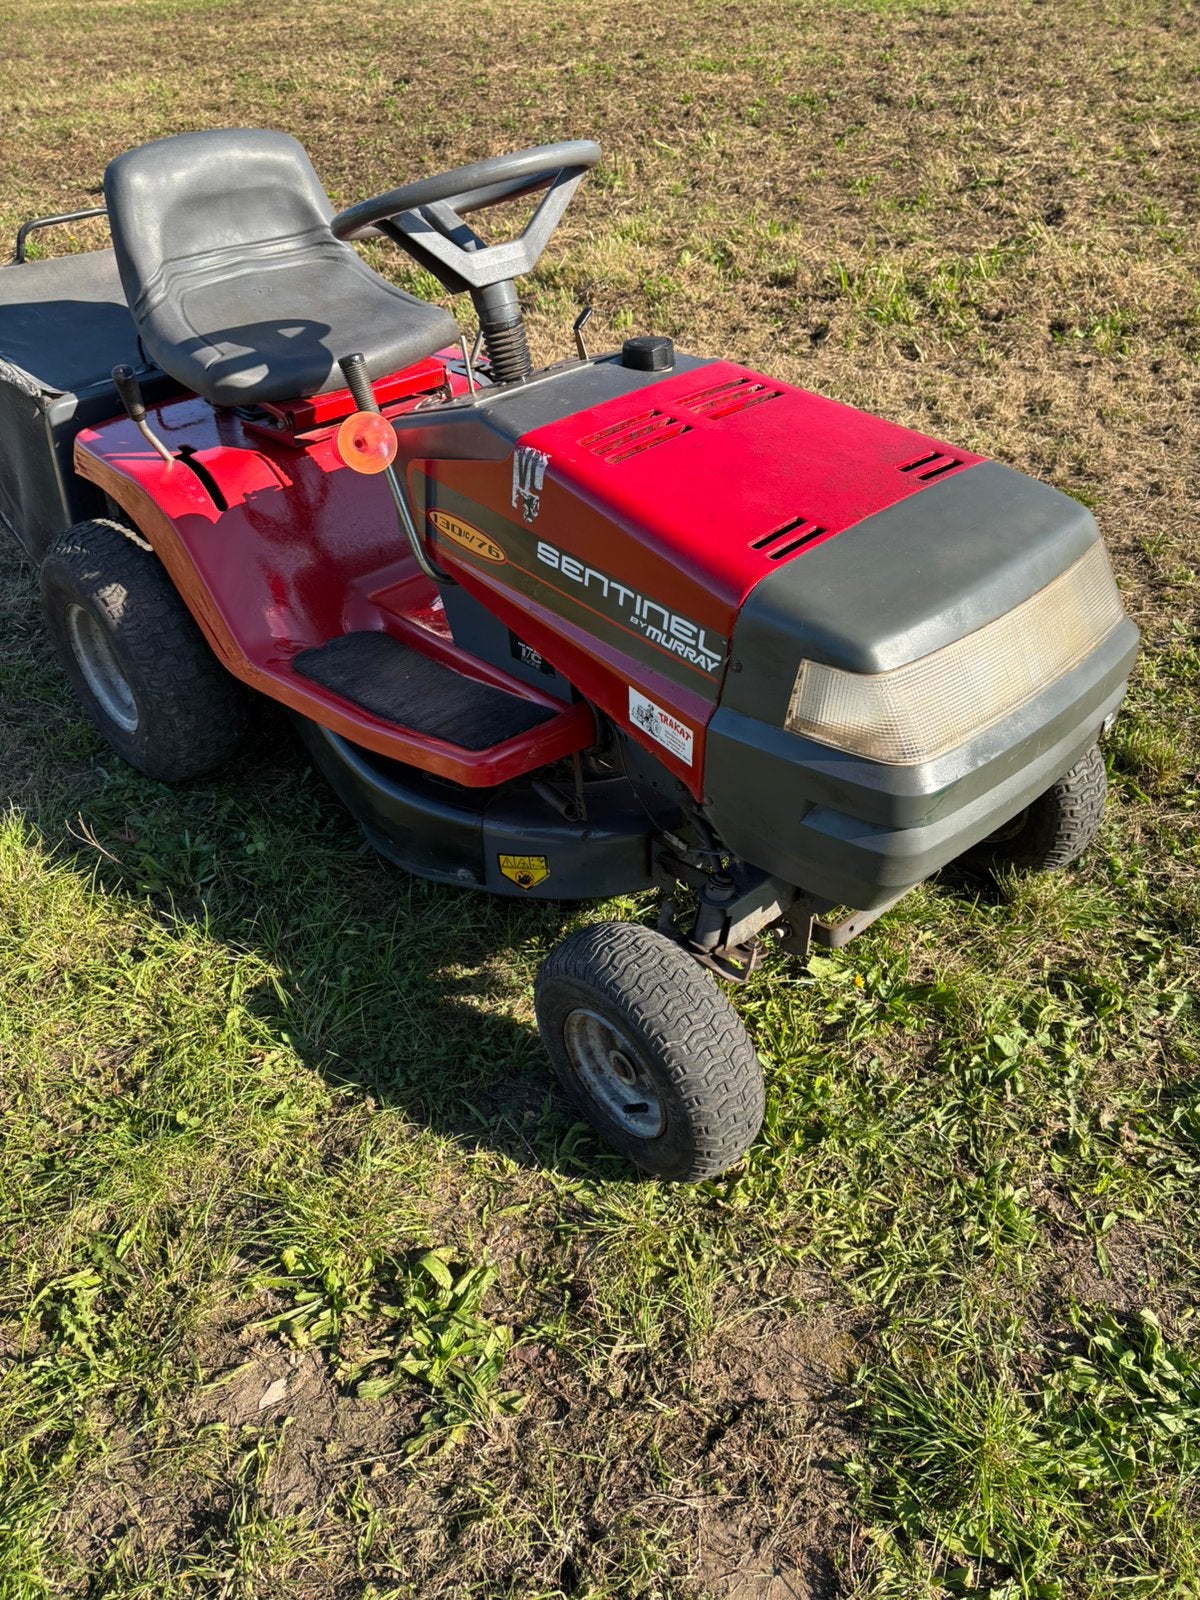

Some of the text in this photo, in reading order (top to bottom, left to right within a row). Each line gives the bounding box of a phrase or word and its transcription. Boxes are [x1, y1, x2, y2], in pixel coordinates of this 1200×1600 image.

[537, 541, 722, 661] SENTINEL
[630, 615, 720, 673] BY MURRAY
[657, 711, 692, 742] TRAKAT
